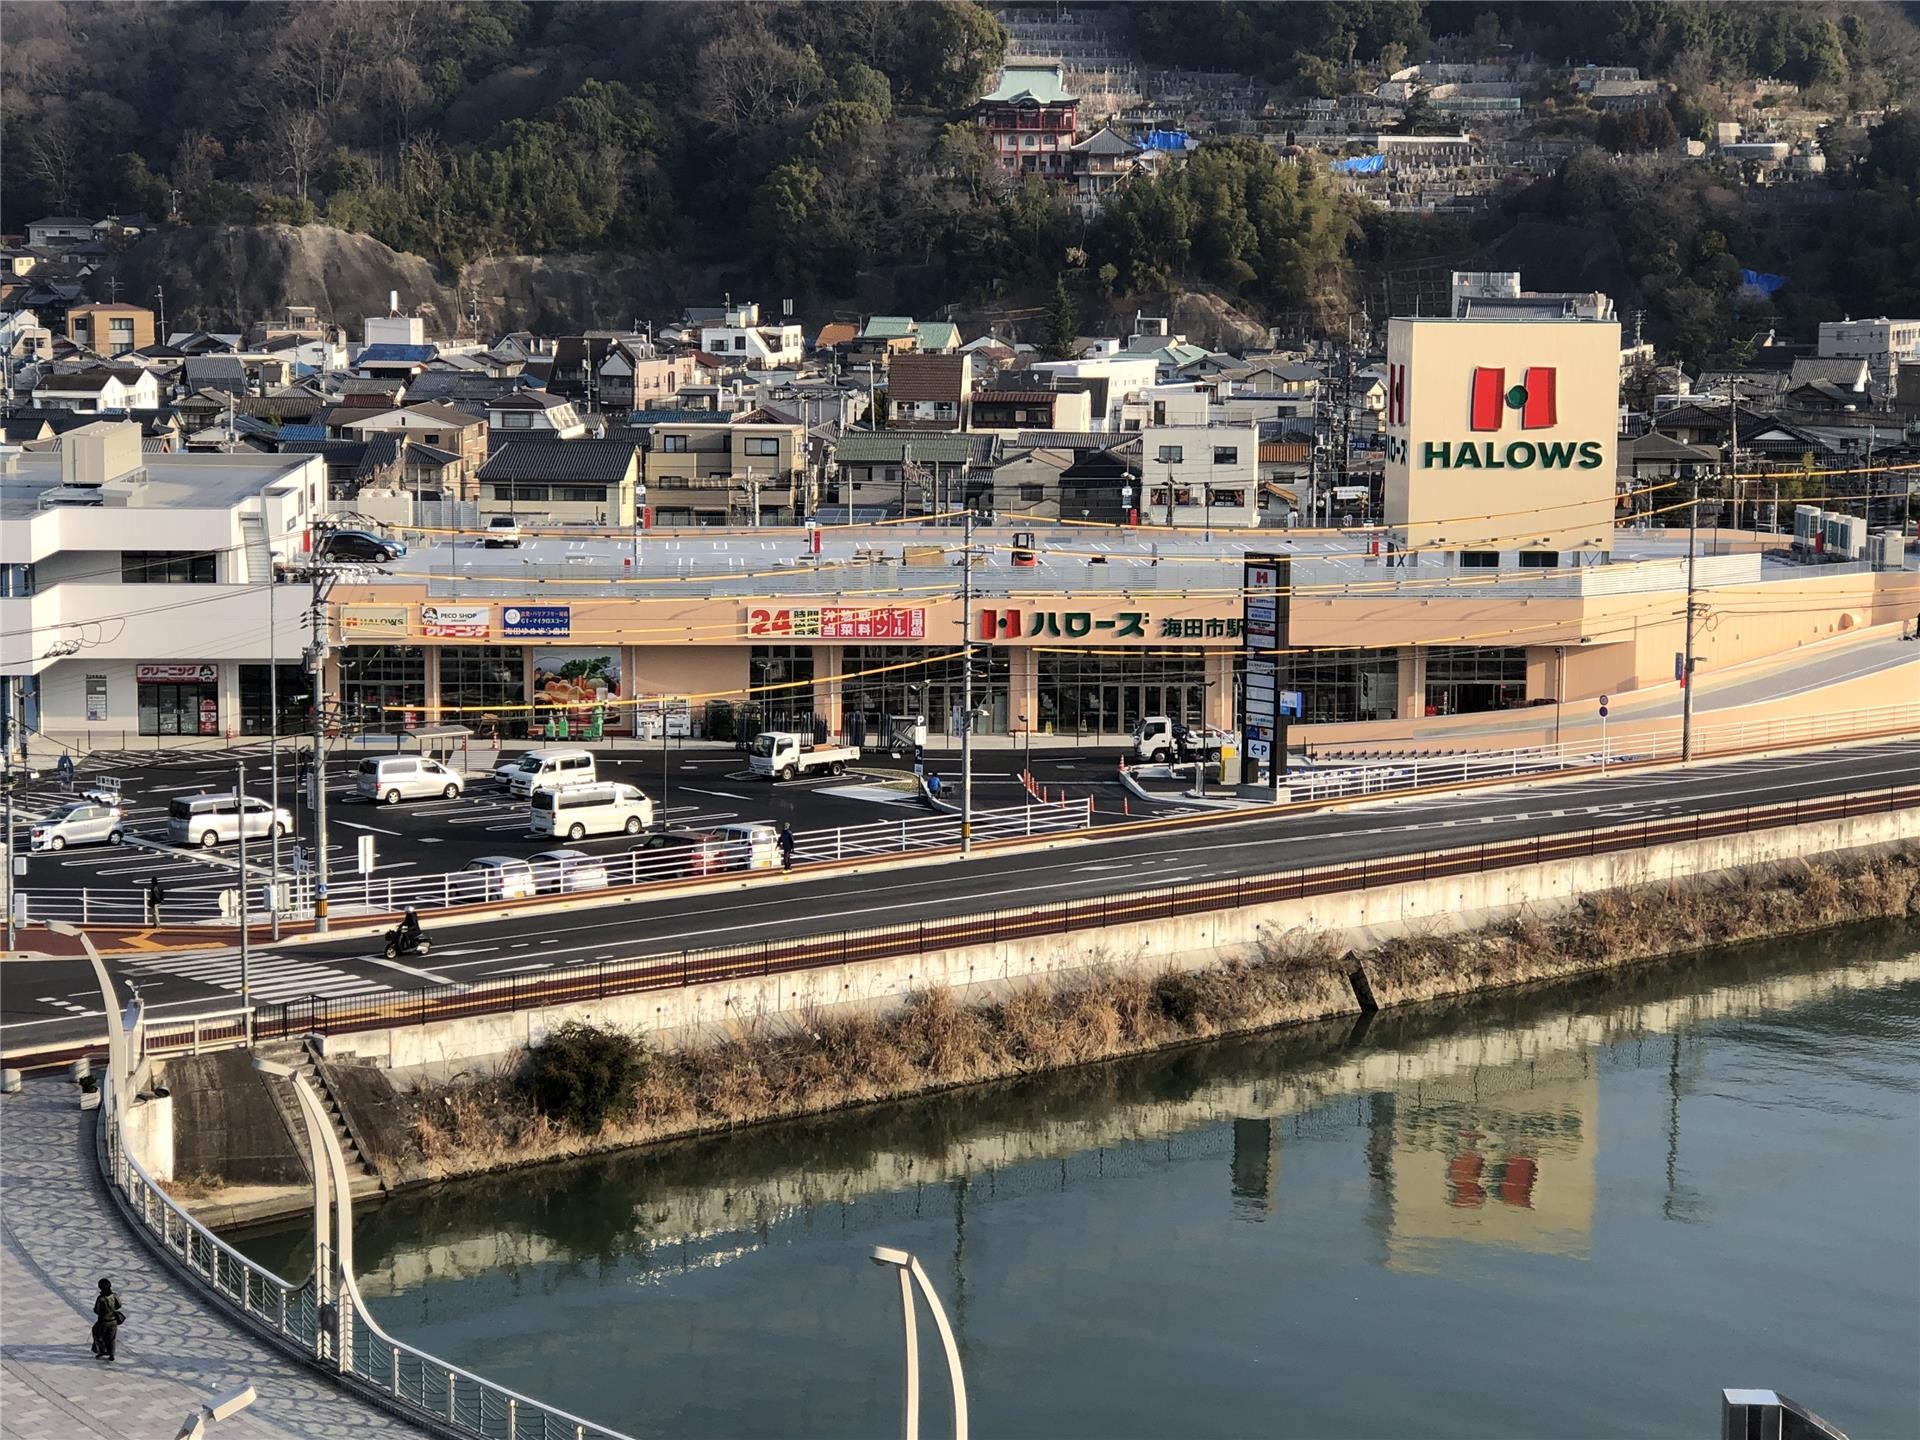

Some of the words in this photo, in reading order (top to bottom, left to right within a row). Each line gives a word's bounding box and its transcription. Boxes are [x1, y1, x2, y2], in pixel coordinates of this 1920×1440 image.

[1424, 441, 1603, 468] HALOWS
[751, 609, 792, 635] 24
[1031, 612, 1150, 637] ハローズ
[141, 666, 196, 676] クリーニング
[917, 716, 924, 725] P
[1260, 745, 1267, 755] P
